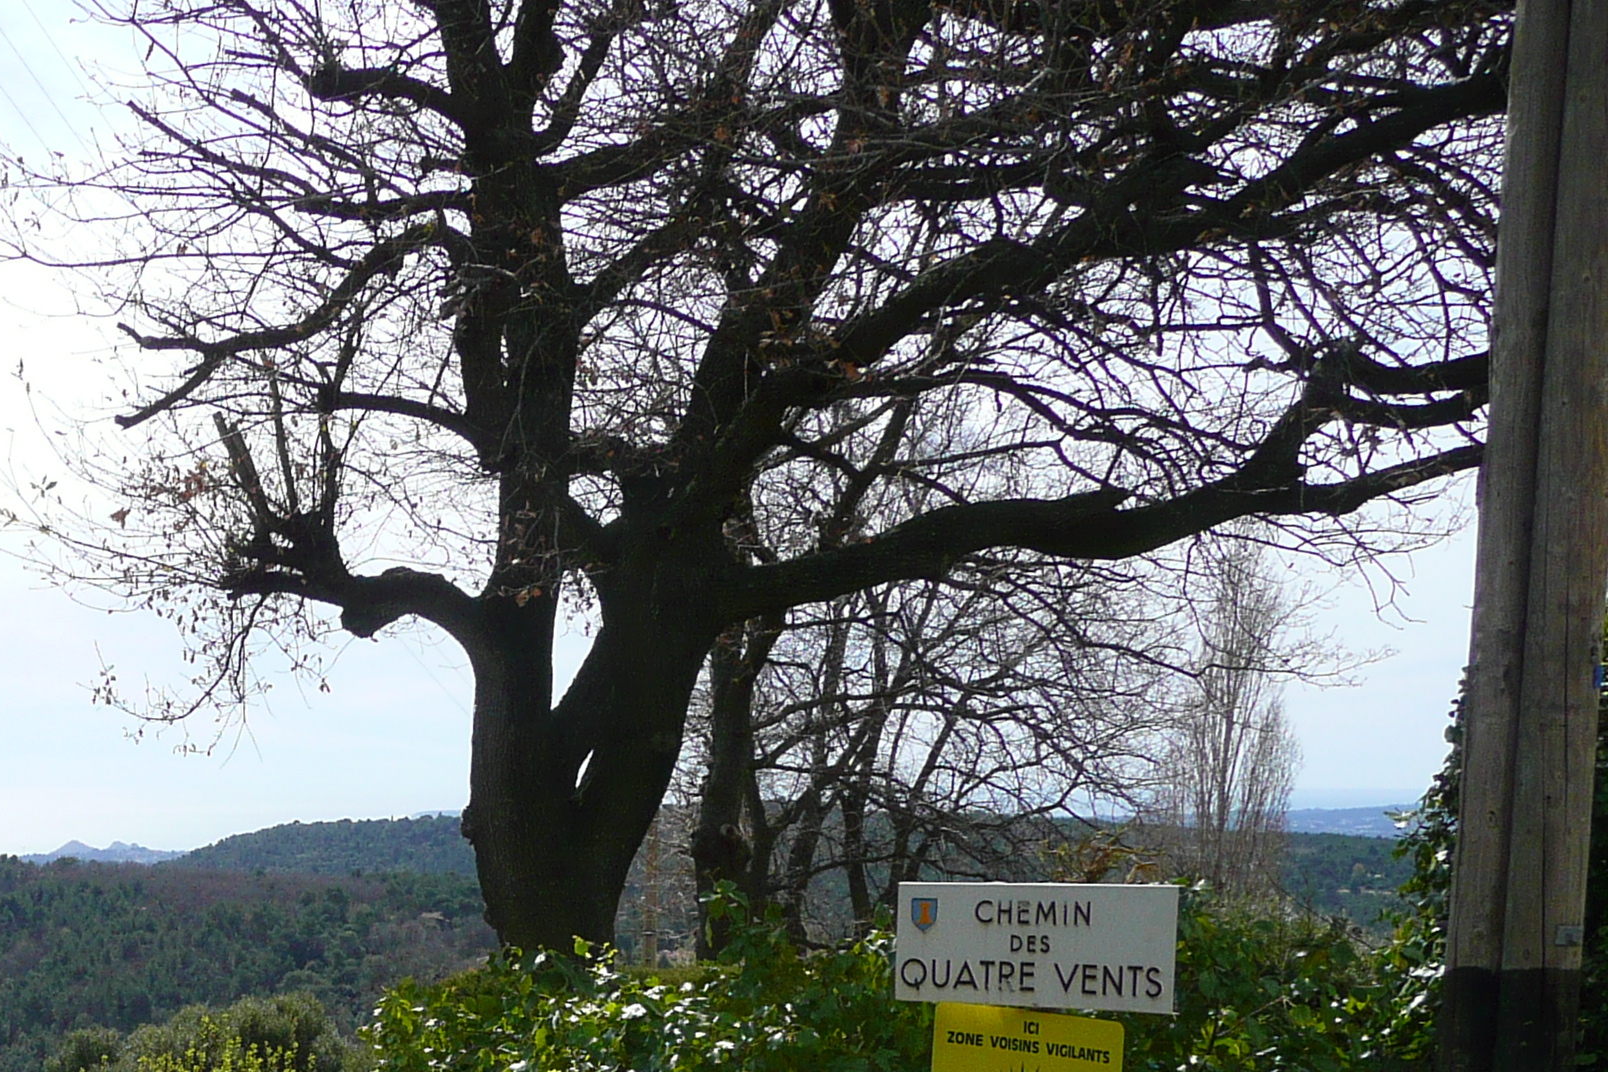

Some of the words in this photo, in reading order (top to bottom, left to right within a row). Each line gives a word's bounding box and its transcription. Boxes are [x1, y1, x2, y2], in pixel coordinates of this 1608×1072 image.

[974, 899, 1092, 927] CHEMIN
[1009, 934, 1051, 954] DES
[900, 957, 1036, 992] QUATRE
[1054, 962, 1164, 999] VENTS
[1023, 1020, 1040, 1036] ICI
[947, 1030, 984, 1047] ZONE
[990, 1035, 1040, 1055] VOISINS
[1046, 1042, 1111, 1065] VIGILANTS
